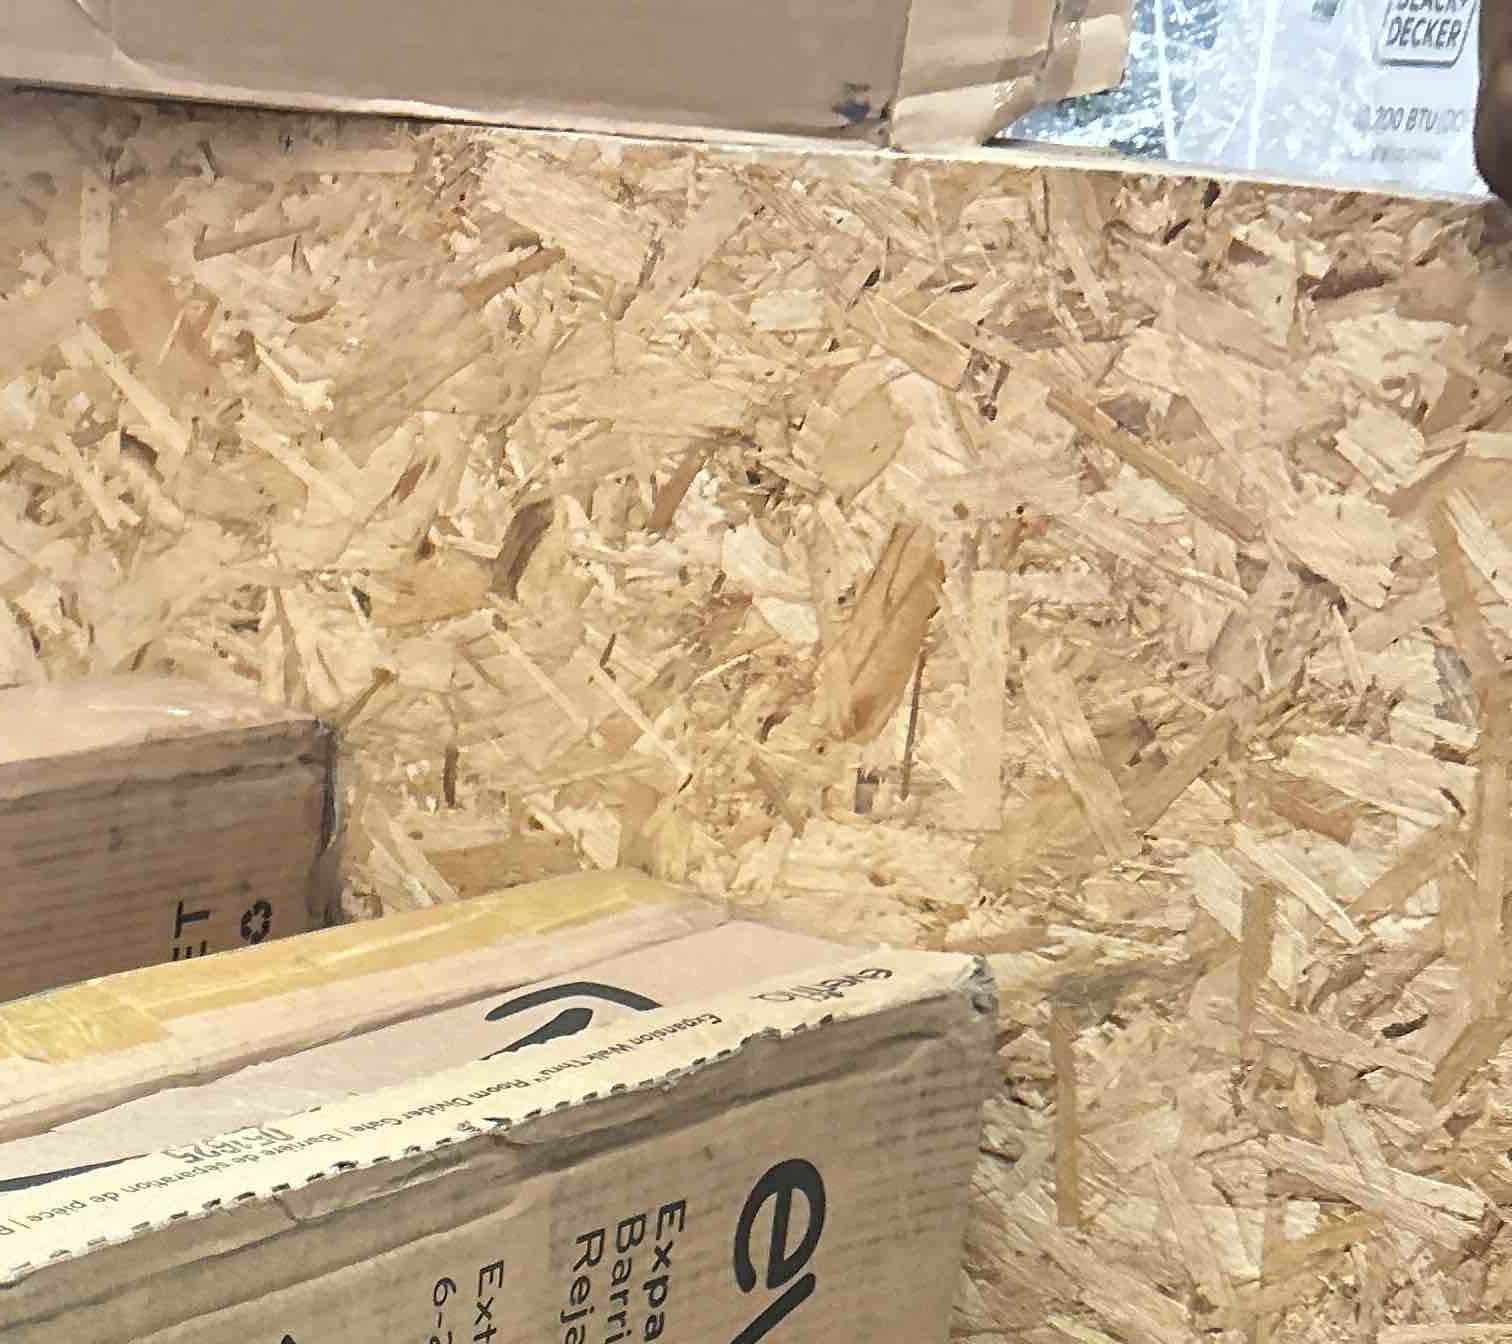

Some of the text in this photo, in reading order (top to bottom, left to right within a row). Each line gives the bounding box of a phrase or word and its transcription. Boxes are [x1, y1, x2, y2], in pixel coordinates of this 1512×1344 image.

[1385, 16, 1463, 49] DECKER
[628, 1013, 722, 1045] Expansion
[587, 1041, 633, 1062] Walk
[466, 1078, 532, 1102] Room
[402, 1096, 473, 1121] Divider
[349, 1115, 404, 1135] Gate
[89, 1189, 120, 1204] de
